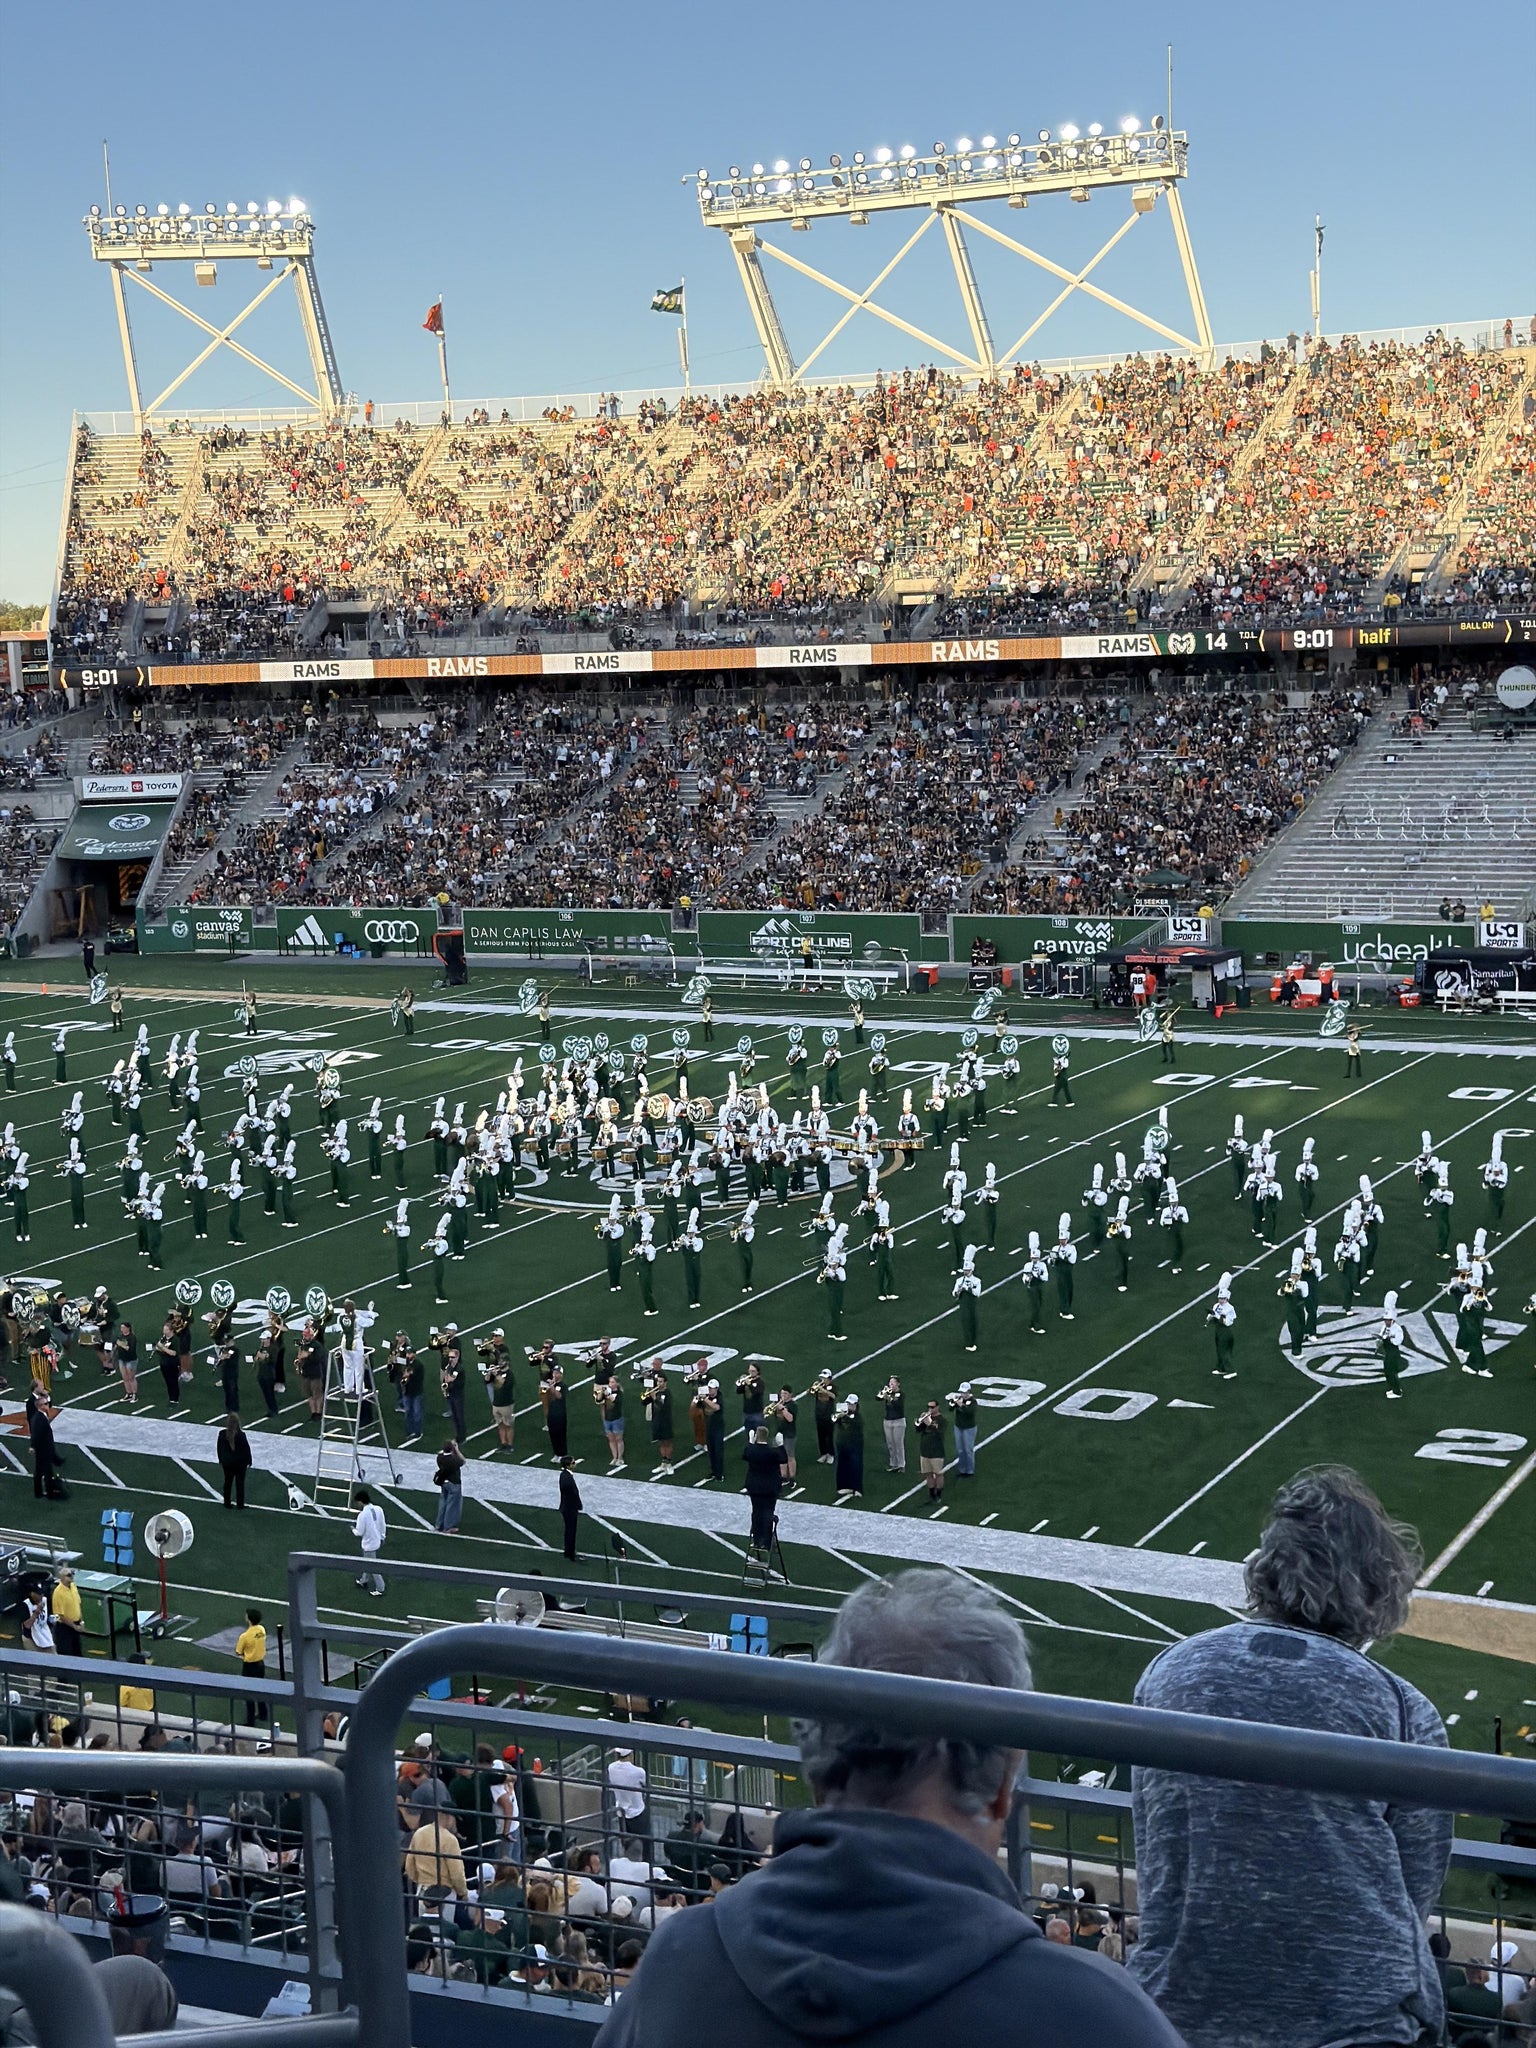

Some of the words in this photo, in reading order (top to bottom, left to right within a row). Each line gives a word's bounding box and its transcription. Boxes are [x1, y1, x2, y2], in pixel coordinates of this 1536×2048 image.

[1460, 622, 1481, 630] BALL
[1482, 621, 1494, 629] ON
[1205, 632, 1228, 651] 14
[1293, 629, 1334, 649] 9:01
[1359, 628, 1391, 645] half
[1523, 631, 1531, 640] 2
[931, 639, 1000, 662] RAMS
[1098, 637, 1150, 654] RAMS
[574, 654, 620, 670] RAMS
[789, 648, 838, 664] RAMS
[293, 663, 341, 678] RAMS
[427, 656, 489, 678] RAMS
[81, 669, 119, 686] 9:01
[146, 782, 178, 790] TOYOTA
[108, 846, 151, 854] TOYOTA
[195, 921, 240, 932] canvas
[470, 926, 498, 938] DAN
[503, 927, 549, 939] CAPLIS
[555, 928, 583, 939] LAW
[196, 931, 225, 940] stadium
[791, 936, 850, 949] CLLINS
[1172, 933, 1202, 941] SPORTS
[1034, 939, 1108, 955] canvas
[1486, 939, 1519, 948] SPORTS
[1472, 968, 1515, 979] Samaritan
